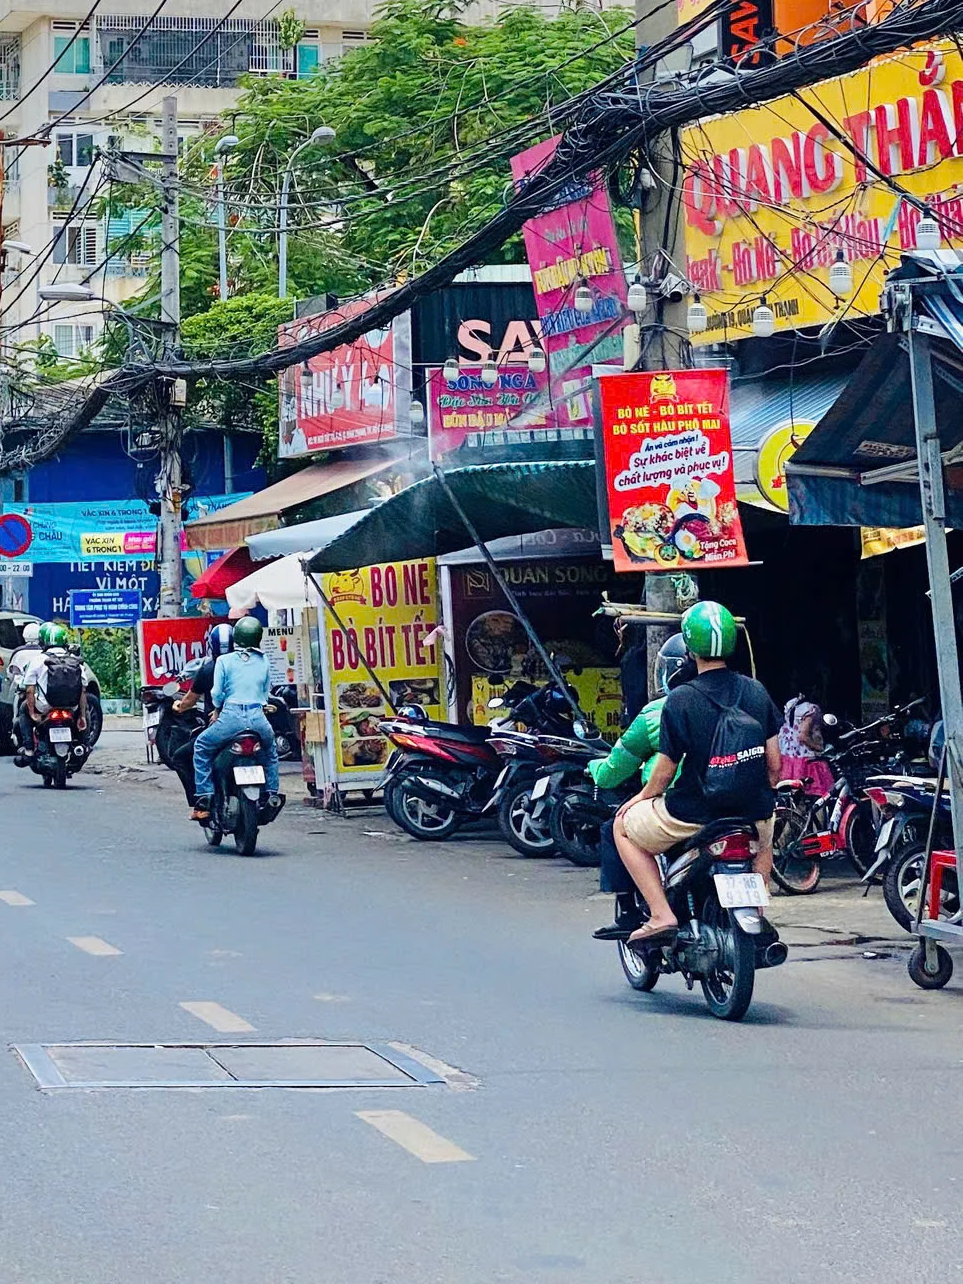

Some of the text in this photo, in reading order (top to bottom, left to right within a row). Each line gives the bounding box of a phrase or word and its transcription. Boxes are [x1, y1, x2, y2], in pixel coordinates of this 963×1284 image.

[618, 406, 633, 419] BÒ
[659, 402, 675, 416] BÒ
[697, 401, 713, 414] TẾT
[630, 420, 651, 434] SỐT
[702, 419, 721, 430] MAI
[655, 441, 663, 450] và
[634, 441, 706, 469] Sự khác biệt về
[618, 471, 641, 487] chất
[643, 468, 672, 483] lượng
[674, 464, 686, 475] và
[687, 461, 710, 476] phục
[96, 573, 111, 590] VÌ
[268, 627, 294, 636] MENU
[332, 617, 360, 671] BÒ
[364, 617, 396, 668] BÍT
[401, 609, 437, 666] TẾT
[150, 636, 186, 678] CƠM
